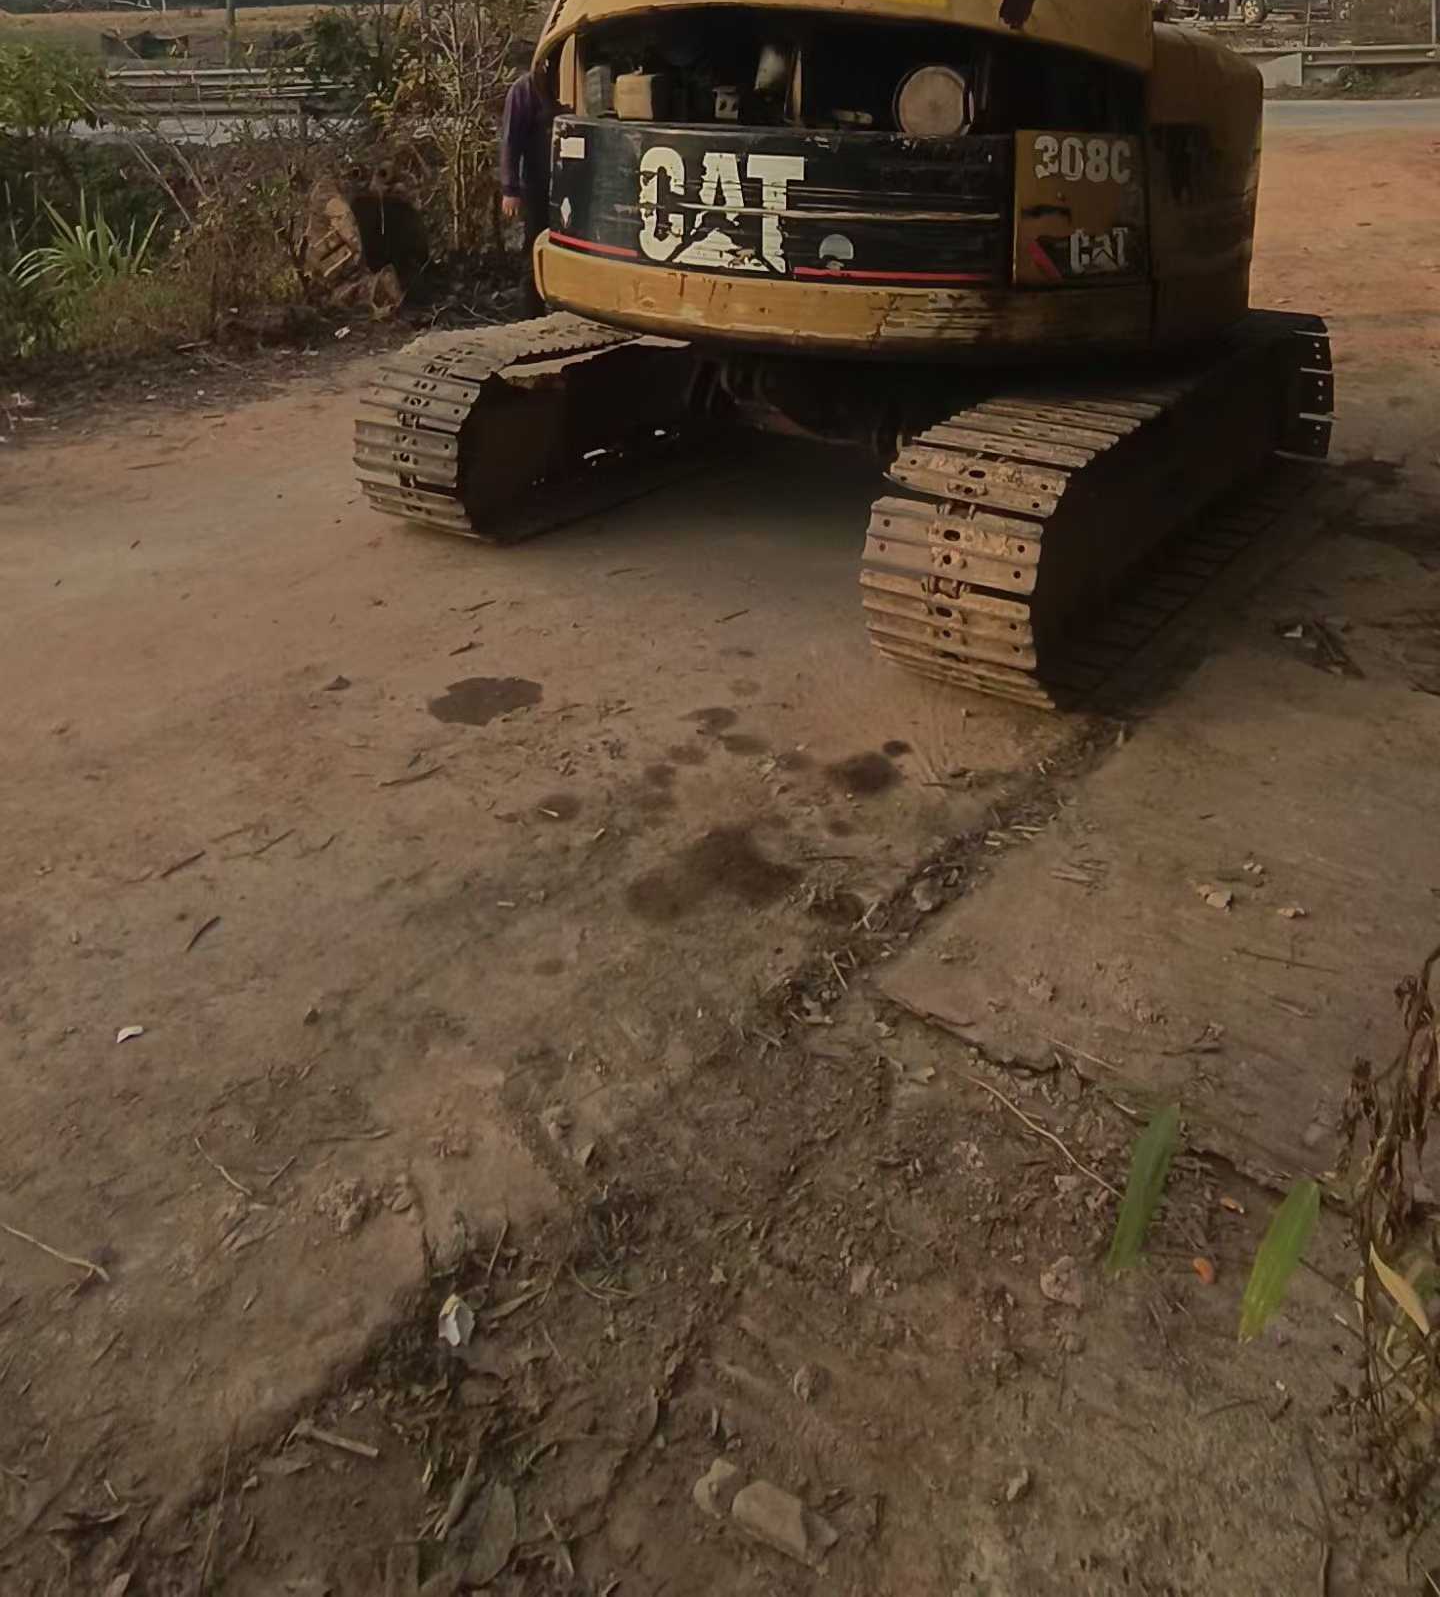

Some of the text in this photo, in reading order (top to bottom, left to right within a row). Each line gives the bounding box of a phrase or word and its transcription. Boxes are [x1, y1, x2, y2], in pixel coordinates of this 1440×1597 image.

[1034, 135, 1131, 184] 308C
[640, 147, 804, 274] CAT
[1070, 227, 1129, 274] CAT
